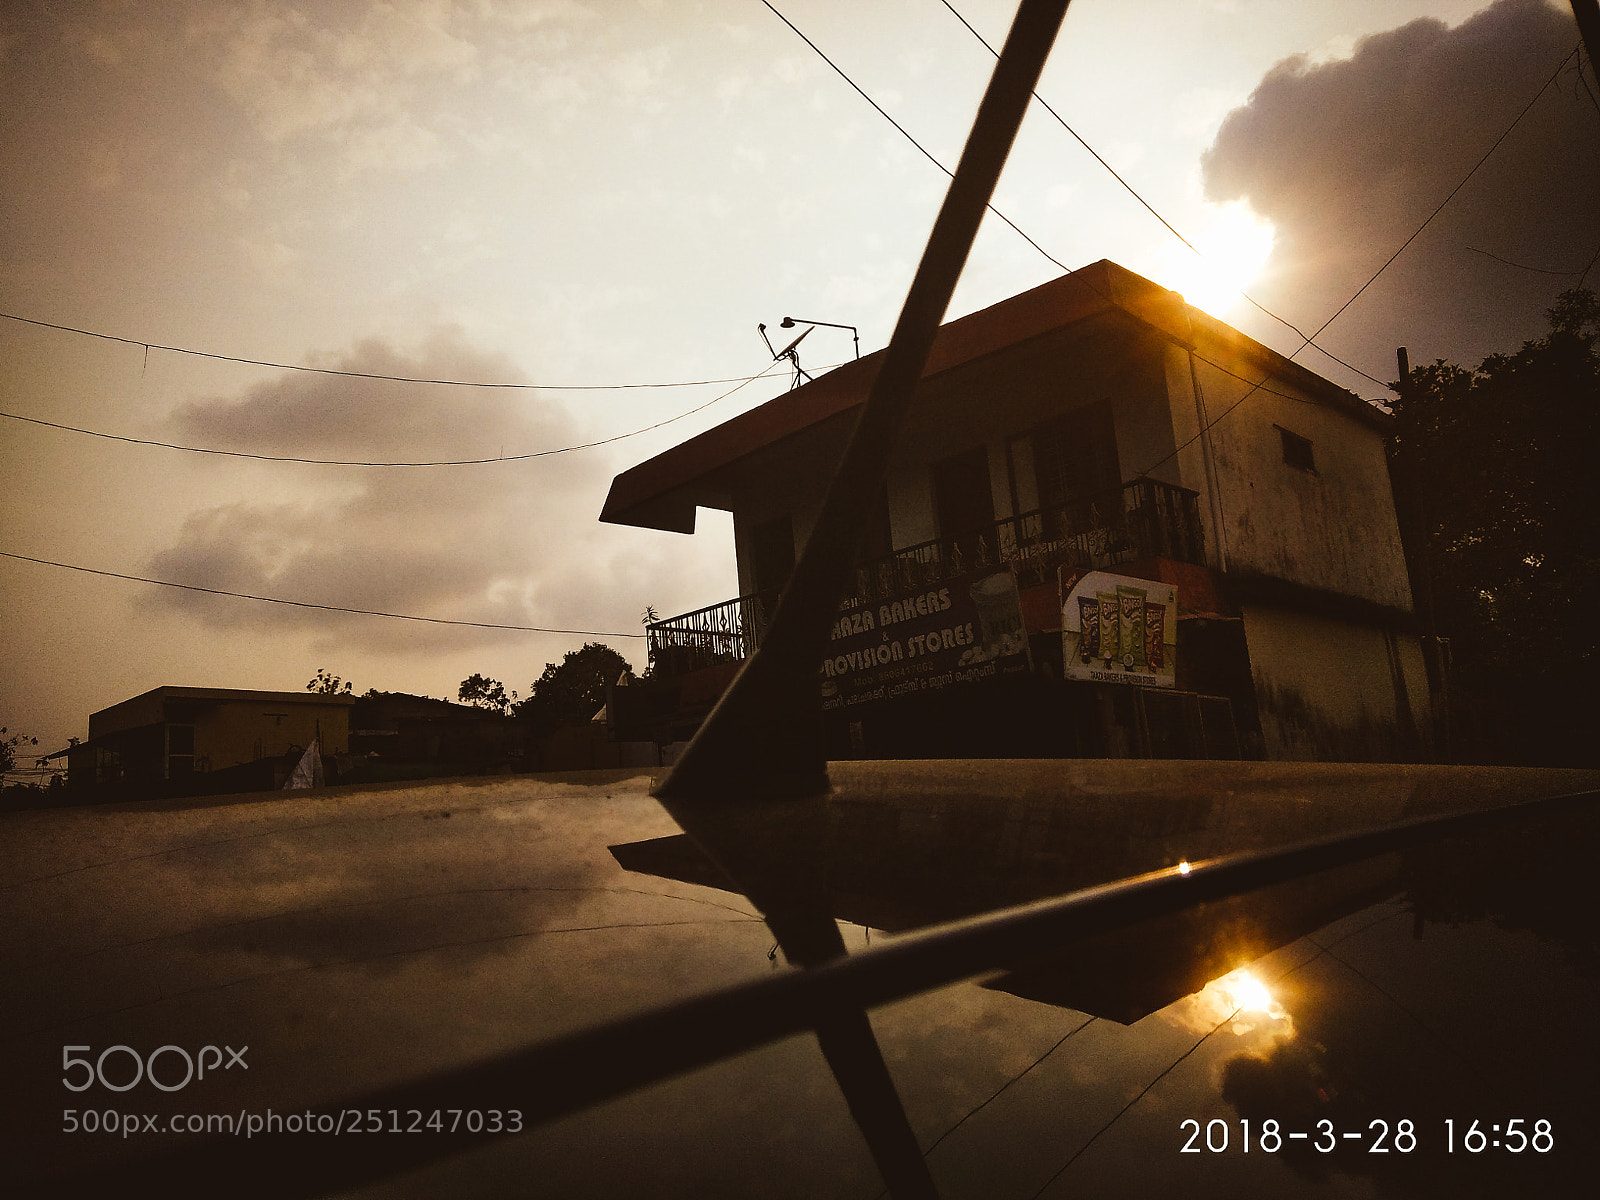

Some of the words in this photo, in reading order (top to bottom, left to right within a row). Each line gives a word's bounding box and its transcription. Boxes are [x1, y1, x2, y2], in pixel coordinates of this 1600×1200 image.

[879, 587, 953, 627] BAKERS
[820, 640, 904, 678] ROVISION
[908, 622, 975, 659] STORES
[882, 631, 890, 643] &
